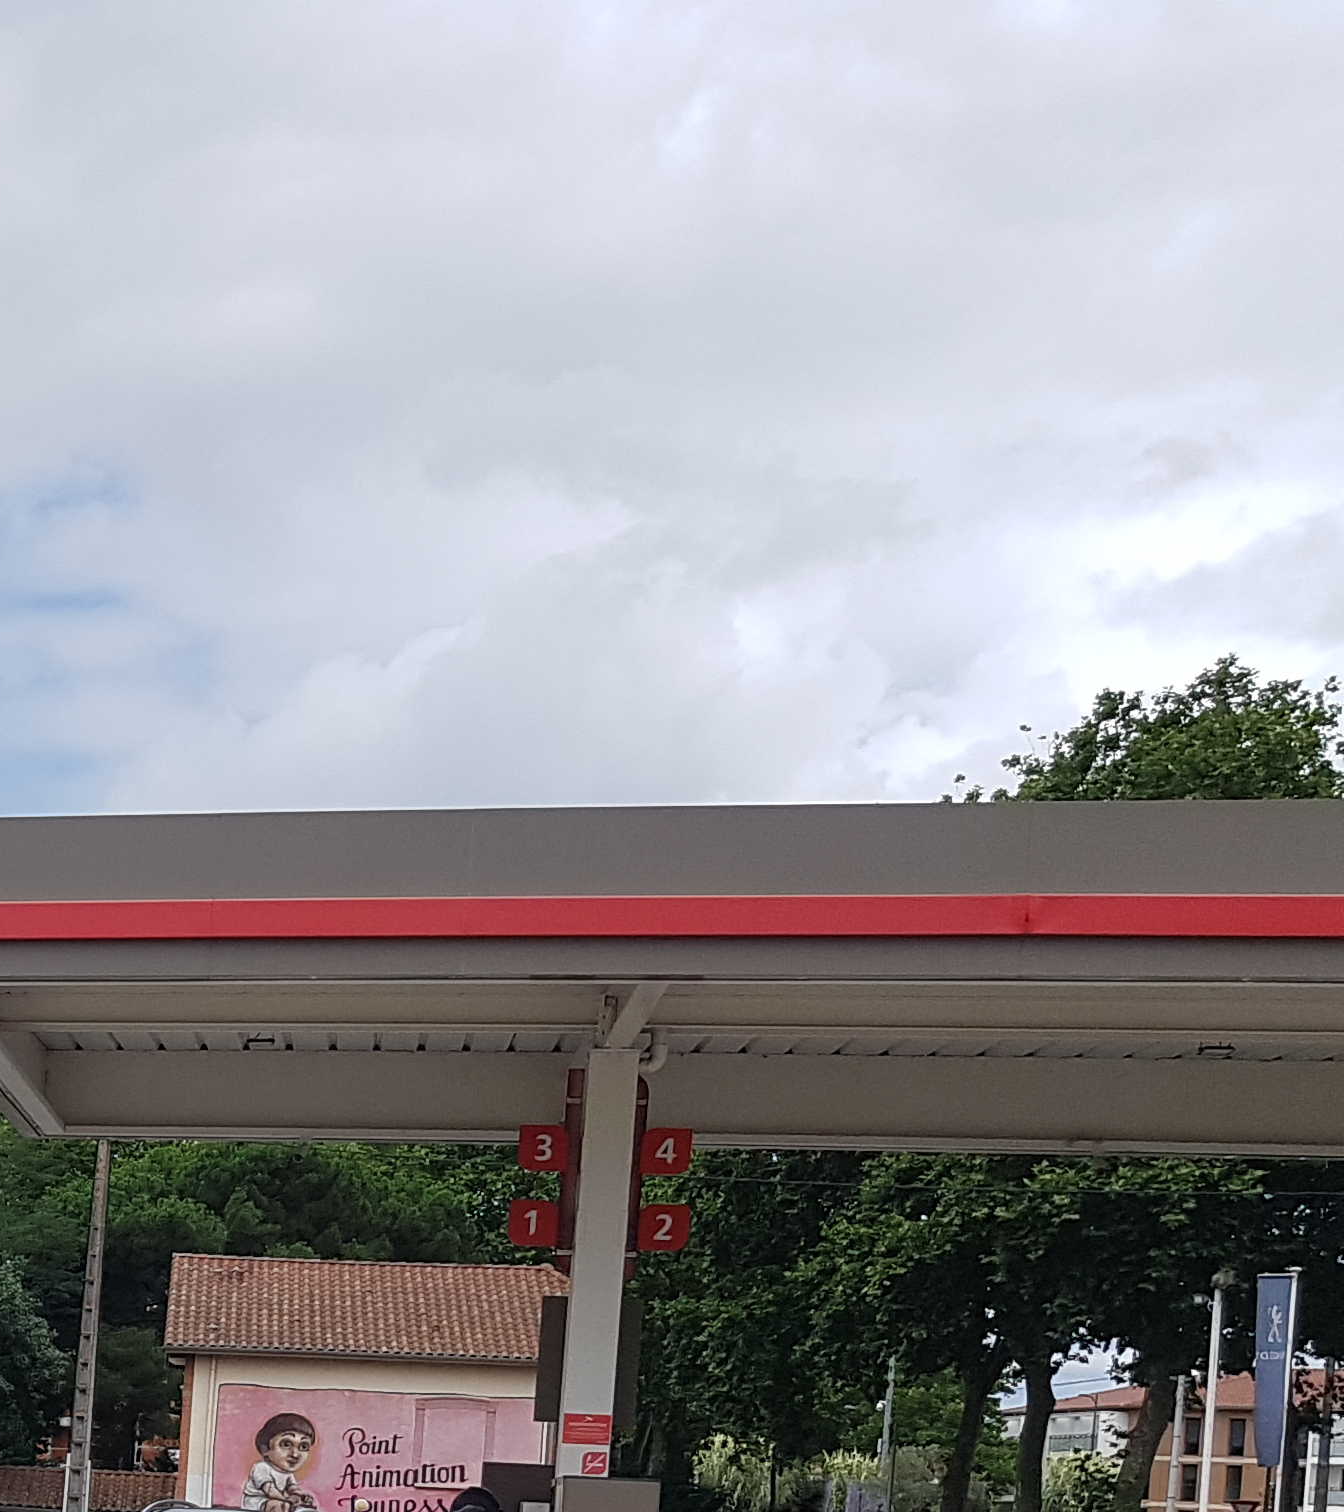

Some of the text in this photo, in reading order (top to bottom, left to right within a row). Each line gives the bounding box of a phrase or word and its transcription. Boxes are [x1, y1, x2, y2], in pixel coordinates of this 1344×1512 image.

[533, 1133, 553, 1162] 3
[654, 1137, 677, 1165] 4
[523, 1209, 538, 1236] 1
[652, 1213, 673, 1241] 2
[342, 1427, 404, 1458] Point
[334, 1463, 469, 1491] Animation
